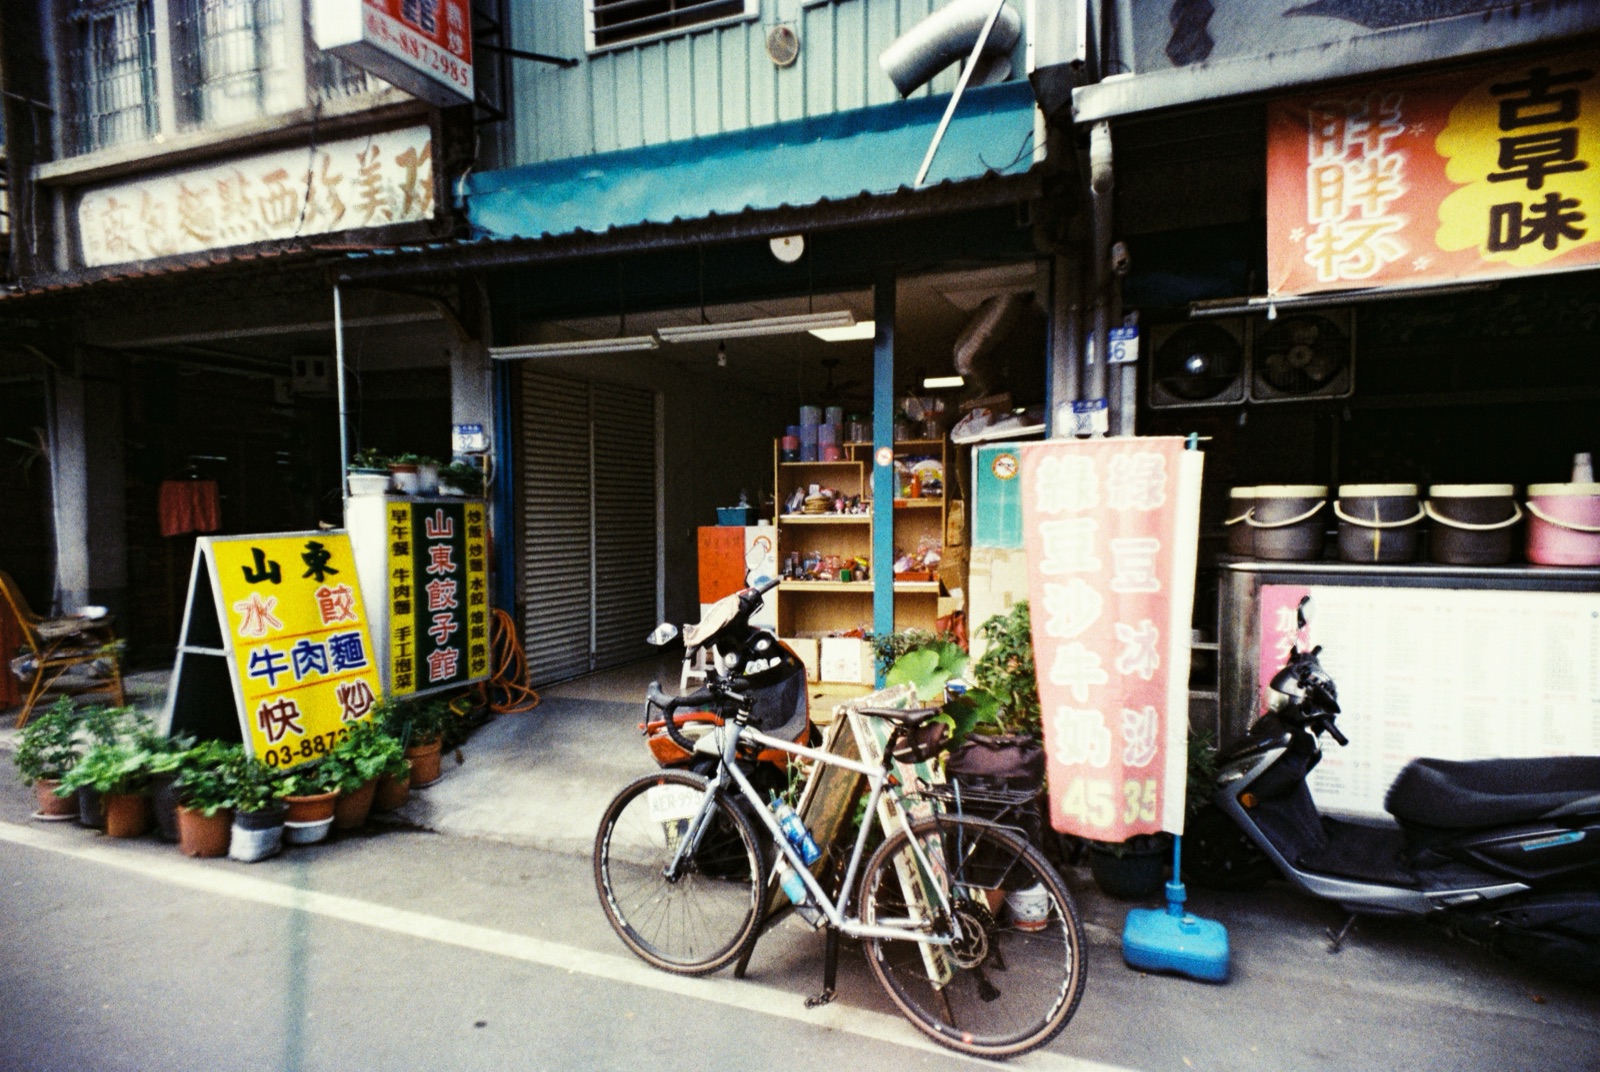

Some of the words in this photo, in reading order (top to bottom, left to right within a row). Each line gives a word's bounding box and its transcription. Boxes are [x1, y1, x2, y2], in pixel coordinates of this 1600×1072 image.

[1487, 67, 1594, 253] 古早味
[392, 567, 411, 616] 牛肉麵
[425, 508, 460, 682] 山東餃子館
[248, 631, 368, 688] 牛肉麵
[393, 625, 412, 689] 手工泡菜
[1060, 776, 1116, 829] 45
[1122, 779, 1158, 824] 35
